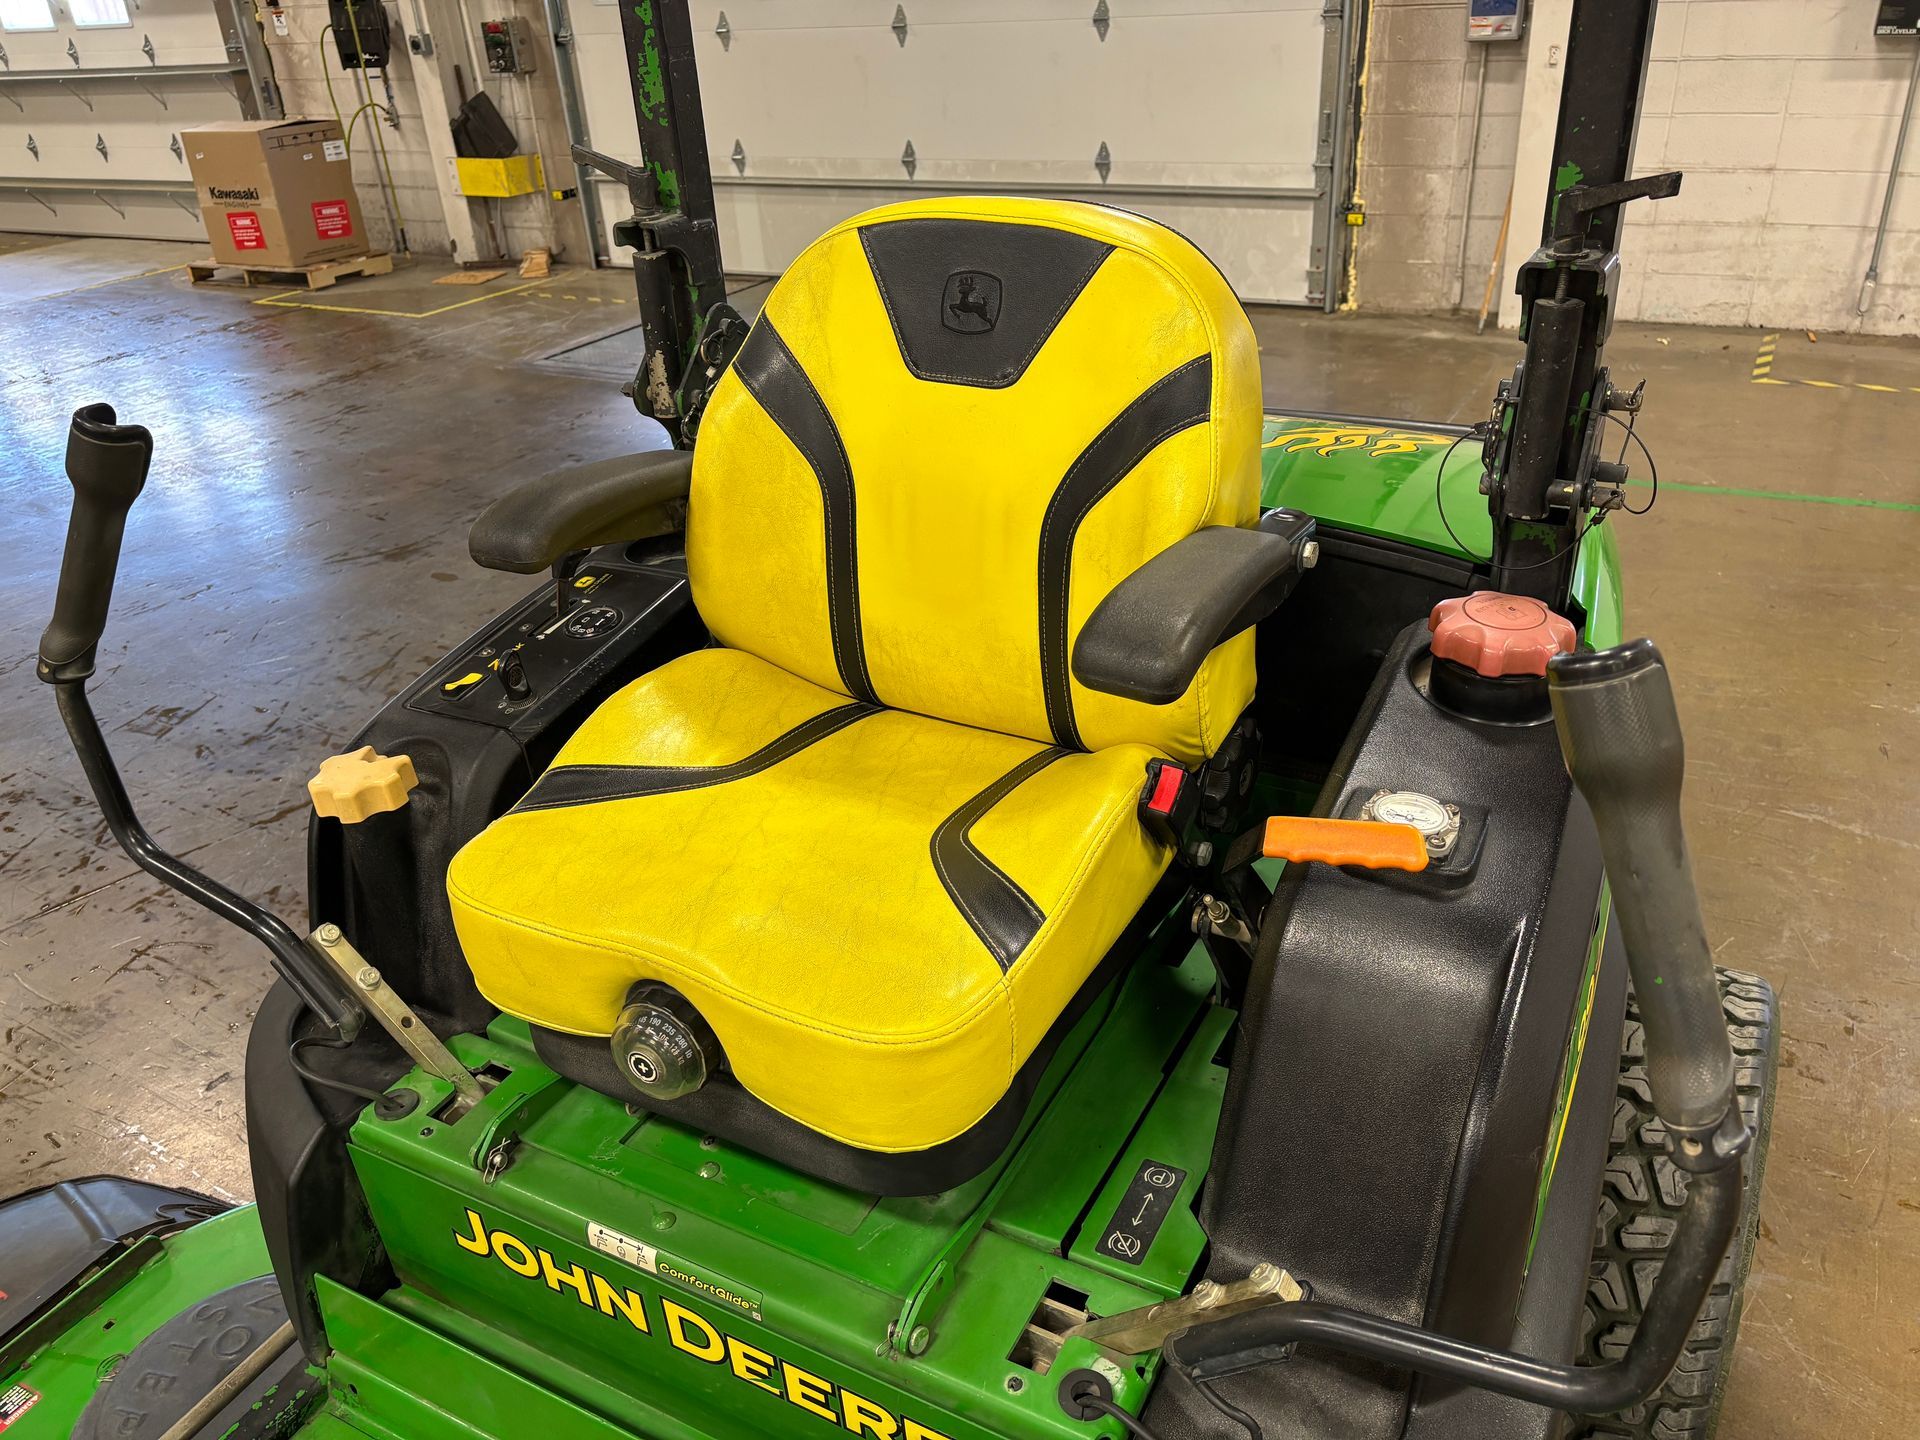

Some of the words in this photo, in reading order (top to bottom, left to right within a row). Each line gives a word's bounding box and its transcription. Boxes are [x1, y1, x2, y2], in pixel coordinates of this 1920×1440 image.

[209, 186, 260, 200] Kawasaki
[649, 1017, 661, 1026] 190
[662, 1023, 677, 1036] 235
[675, 1034, 688, 1049] 280
[685, 1048, 693, 1059] lb
[453, 1208, 651, 1338] JOHN
[659, 1295, 954, 1440] DEER
[113, 1302, 228, 1436] STEP
